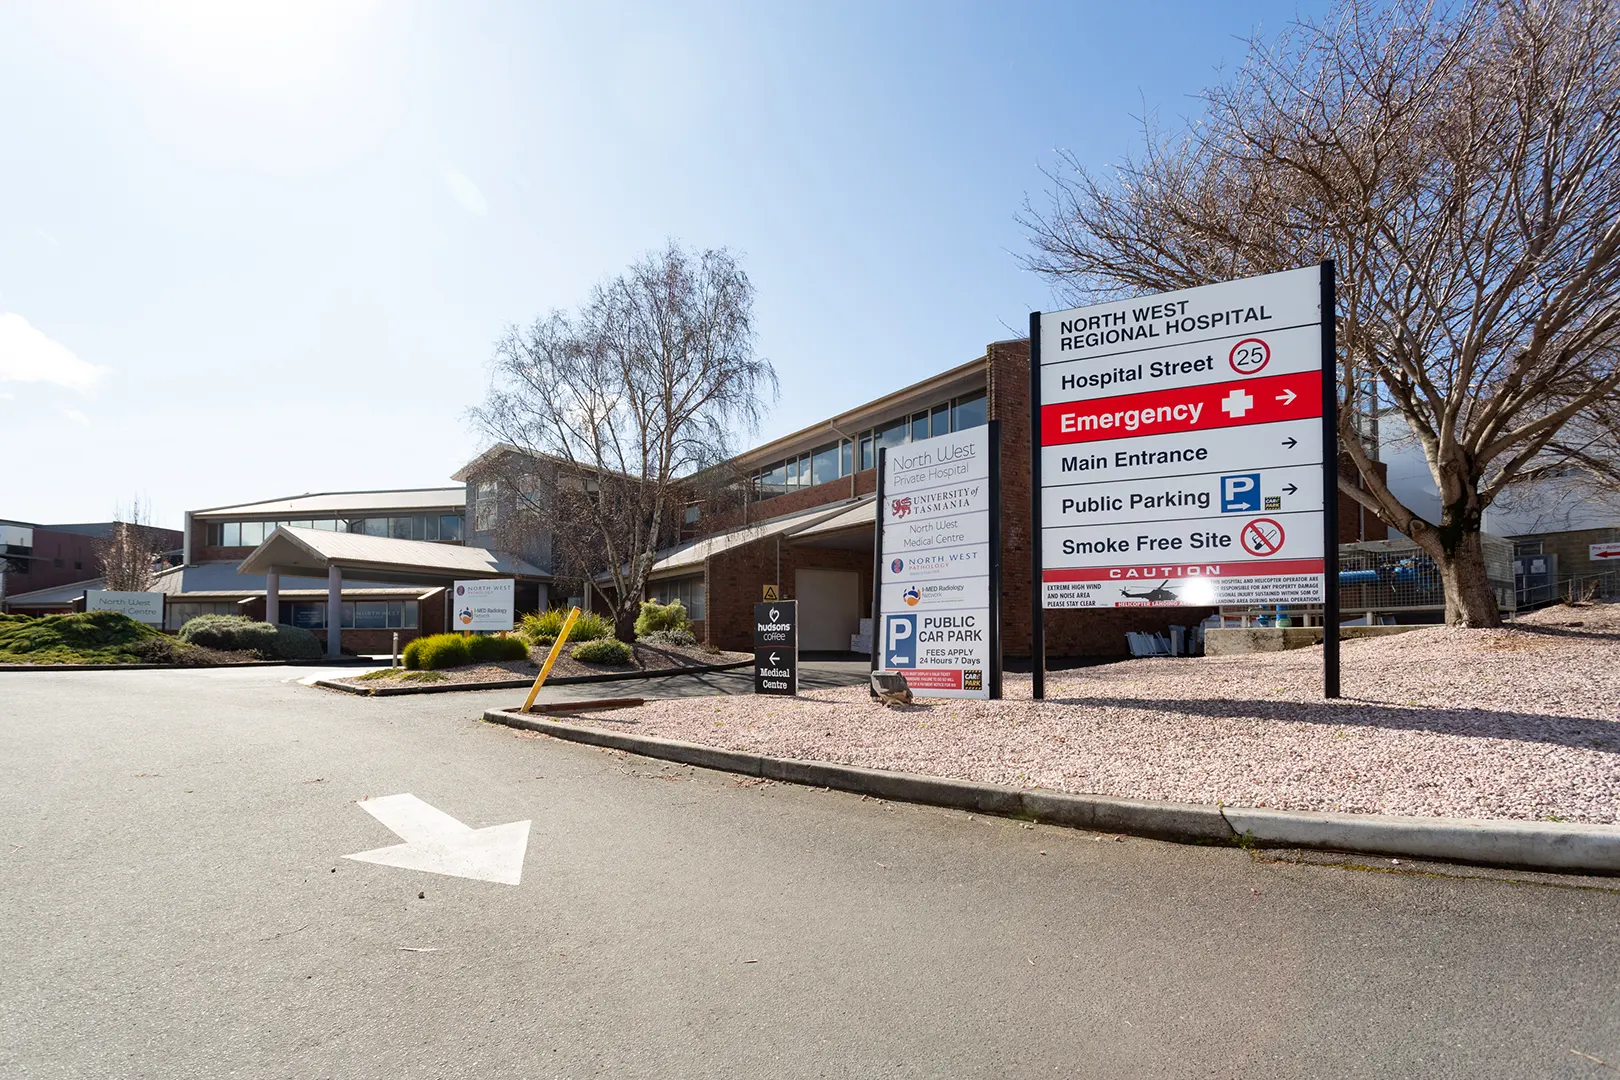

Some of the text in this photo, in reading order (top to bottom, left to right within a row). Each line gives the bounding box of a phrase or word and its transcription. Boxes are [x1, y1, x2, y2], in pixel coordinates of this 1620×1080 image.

[1060, 300, 1189, 335] NORTH WEST
[1060, 305, 1272, 351] REGIONAL HOSPITAL
[1236, 346, 1263, 366] 25
[1062, 355, 1214, 390] Hospital Street
[1060, 402, 1204, 433] Emergency
[894, 443, 976, 472] North West
[1062, 447, 1208, 472] Main Entrance
[894, 462, 968, 486] Private Hospital
[914, 486, 980, 504] UNIVERSITY of
[1225, 477, 1254, 501] P
[914, 499, 970, 514] TASMANIA
[1062, 489, 1210, 514] Public Parking
[910, 520, 958, 534] North West
[904, 534, 964, 548] Medical Centre
[1062, 530, 1232, 555] Smoke Free Site
[909, 552, 978, 565] NORTH WEST
[1110, 566, 1220, 578] CAUTION
[758, 623, 791, 632] hudsons
[924, 616, 975, 628] PUBLIC
[763, 632, 786, 641] coffee
[890, 618, 912, 651] P
[918, 630, 982, 642] CAR PARK
[961, 657, 981, 665] Days
[760, 668, 790, 677] Medical
[763, 680, 787, 689] Centre
